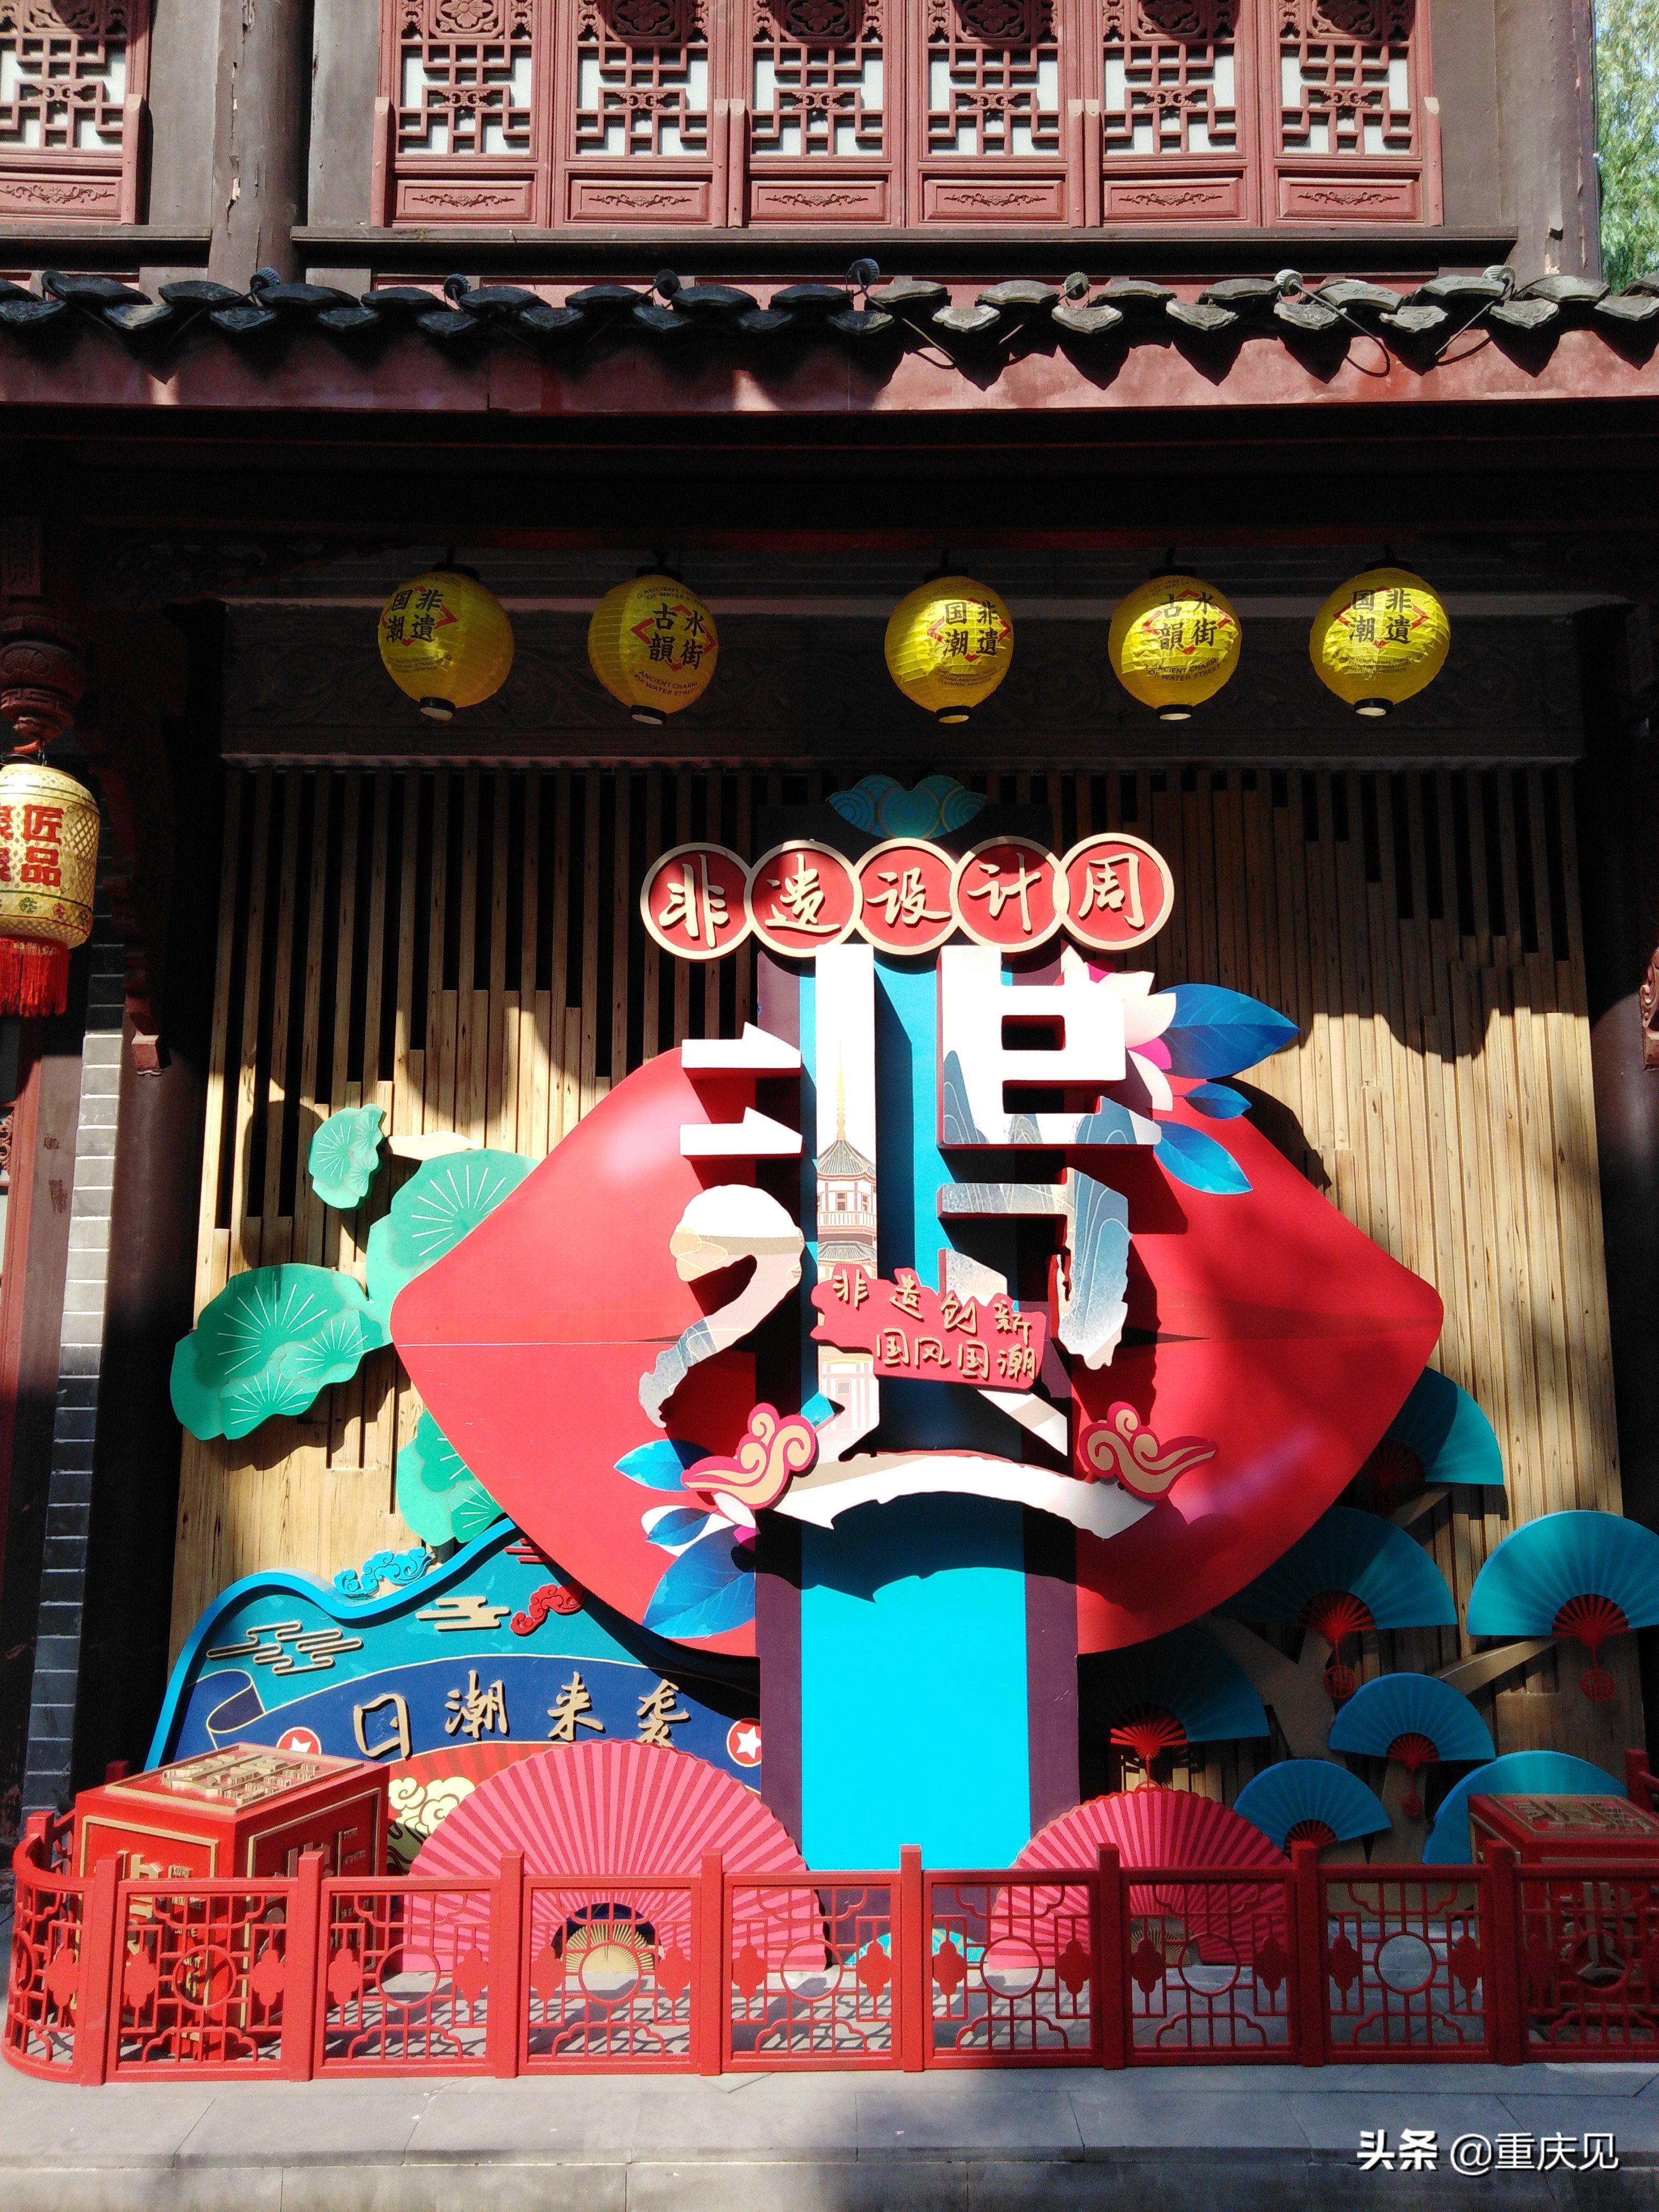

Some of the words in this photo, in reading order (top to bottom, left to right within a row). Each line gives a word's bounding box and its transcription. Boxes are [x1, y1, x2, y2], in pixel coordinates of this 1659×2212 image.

[1152, 663, 1187, 674] ANCIENT
[1189, 658, 1218, 673] CHARM
[1193, 663, 1221, 678] STREET
[639, 671, 671, 688] ANCIENT
[646, 682, 673, 695] WATER
[20, 803, 64, 887] 匠品
[657, 852, 1145, 948] 非遗设计周
[875, 1327, 1036, 1381] 国风国潮
